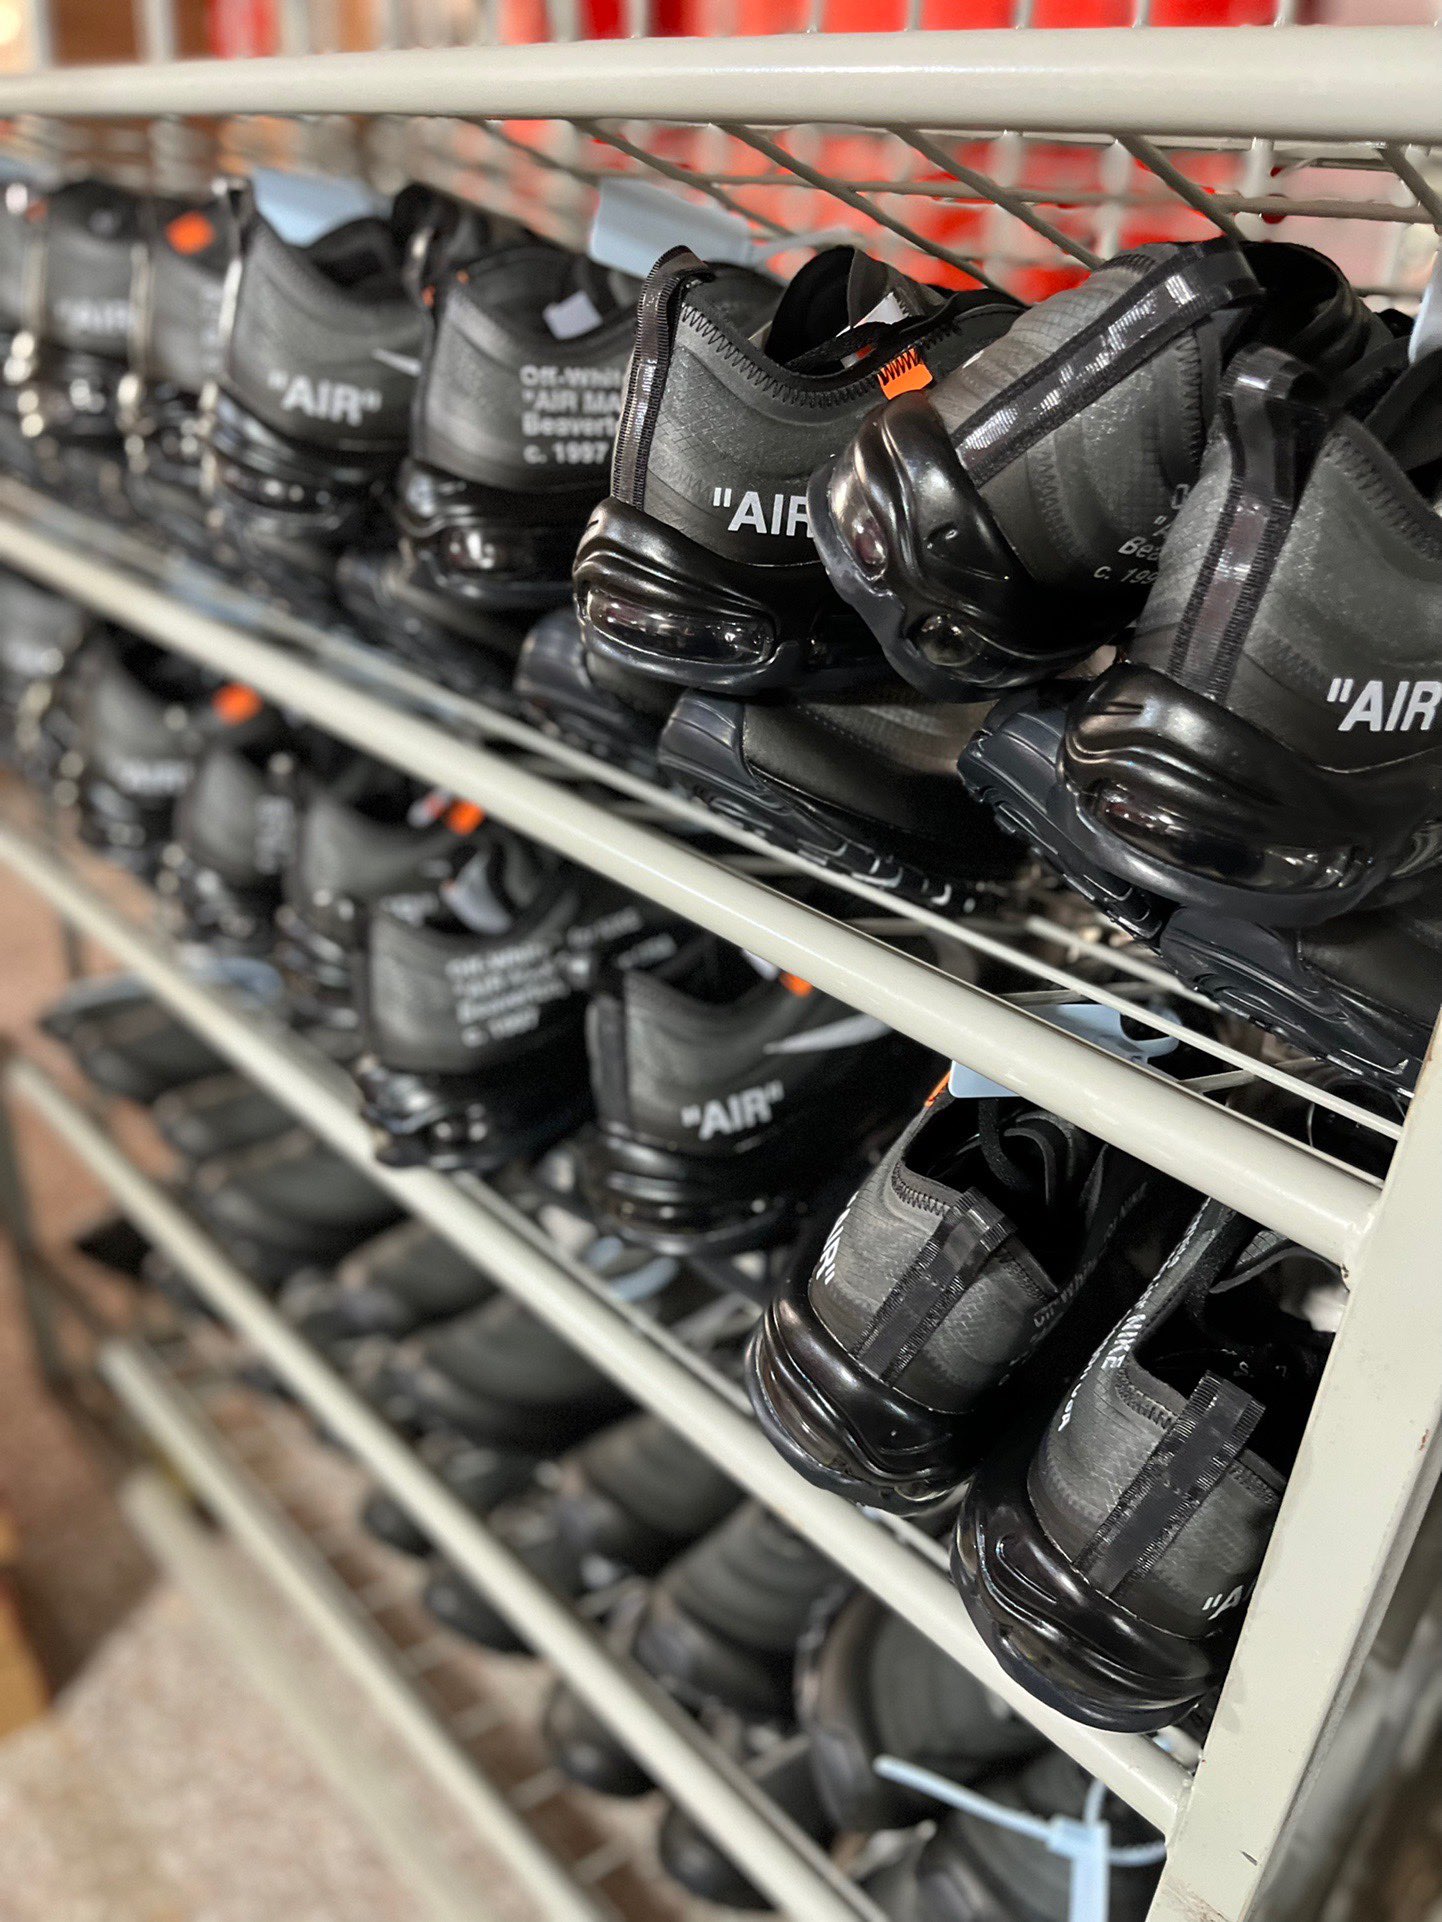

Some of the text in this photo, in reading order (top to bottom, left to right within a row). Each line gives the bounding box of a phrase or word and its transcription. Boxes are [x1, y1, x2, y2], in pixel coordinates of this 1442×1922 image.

[266, 369, 383, 427] "AIR"
[523, 441, 610, 465] c. 1997
[712, 486, 816, 539] "AIR
[1093, 565, 1112, 580] c.
[1326, 676, 1442, 732] "AIR
[681, 1080, 785, 1140] "AIR"
